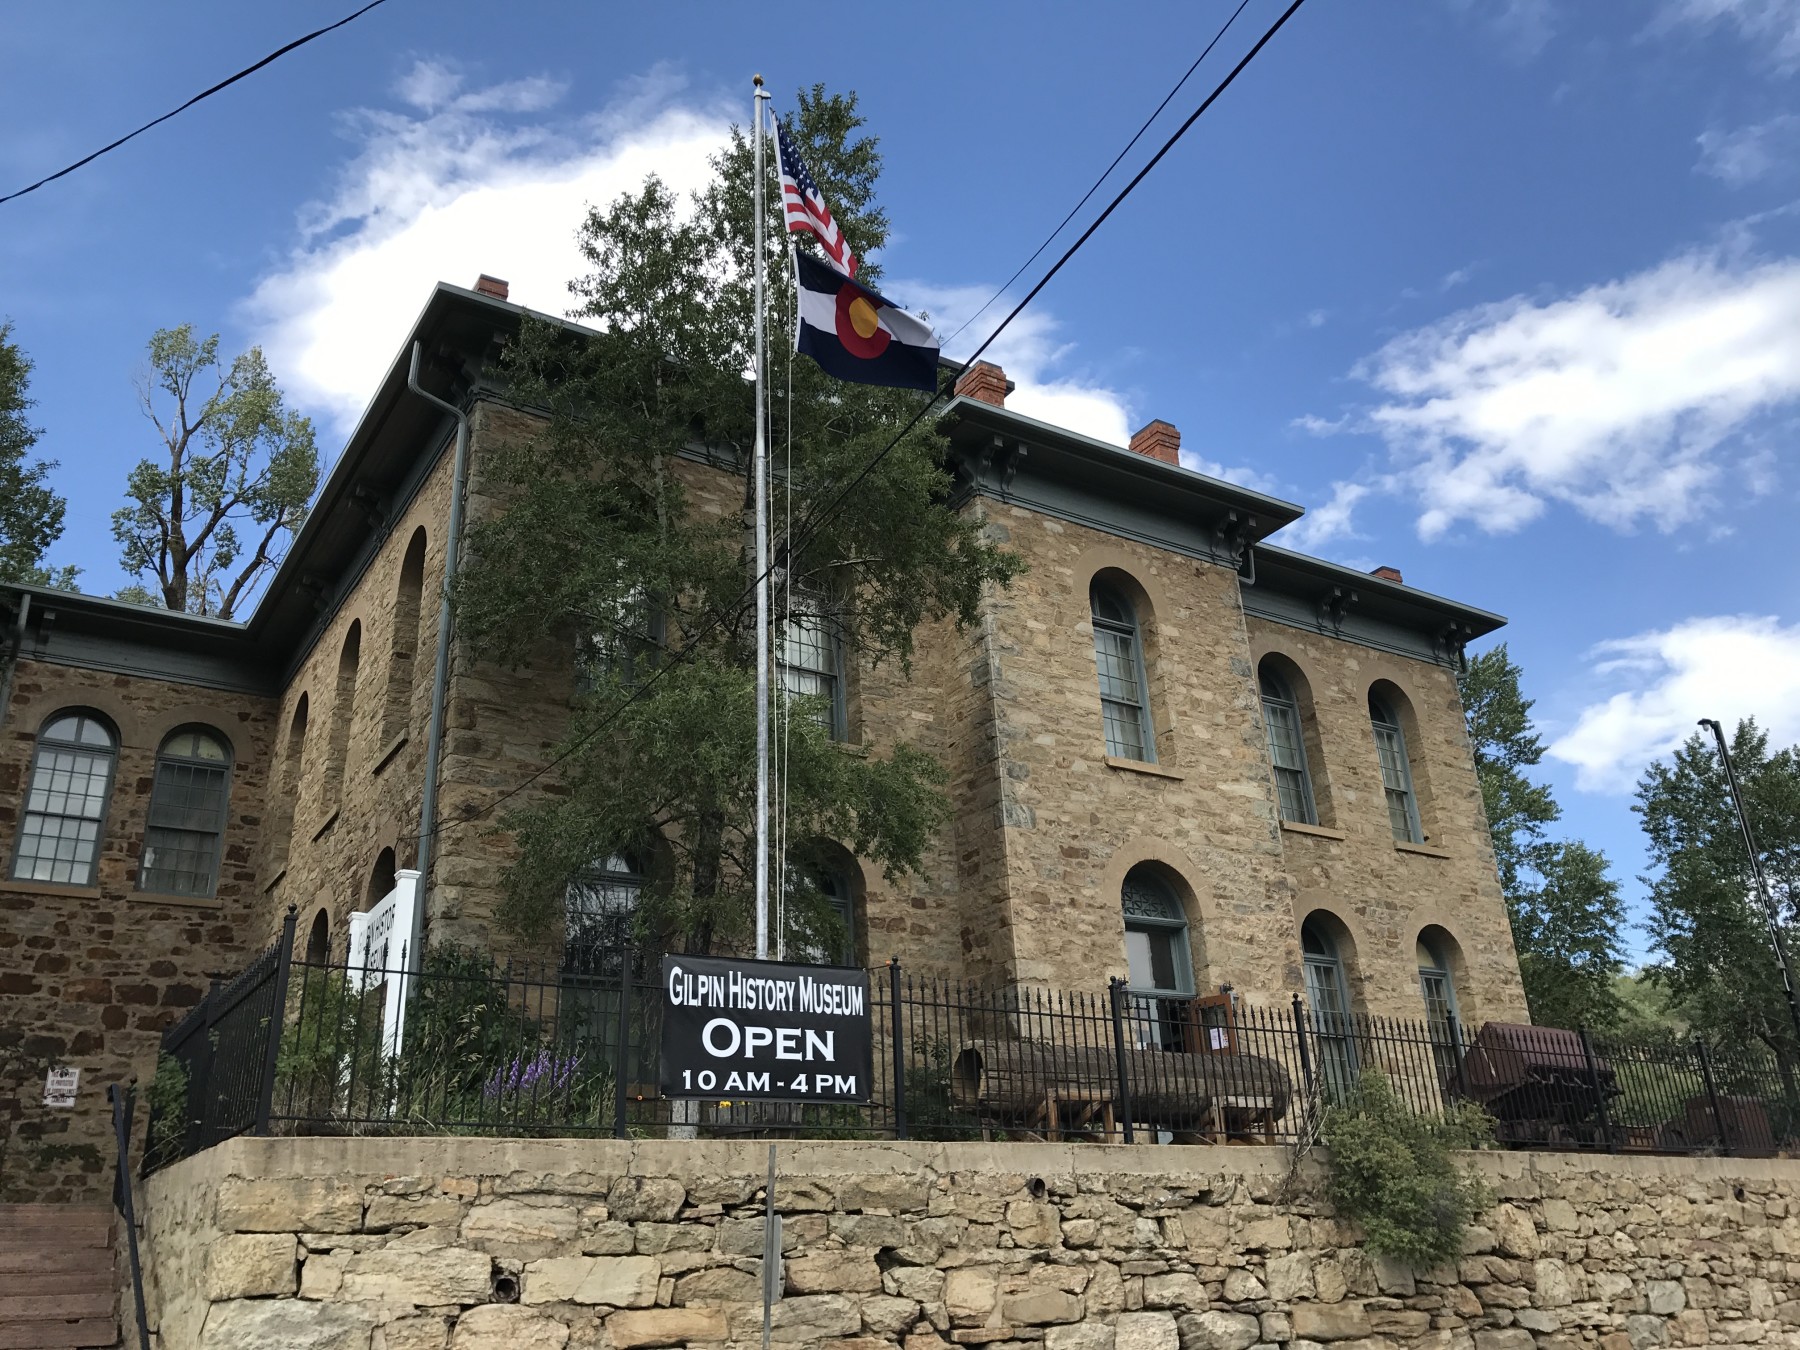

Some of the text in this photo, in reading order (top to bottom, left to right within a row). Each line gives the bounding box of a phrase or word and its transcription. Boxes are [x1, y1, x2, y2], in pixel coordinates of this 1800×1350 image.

[669, 966, 864, 1016] GILPIN HISTORY MUSEUM
[702, 1017, 835, 1062] OPEN
[683, 1069, 717, 1090] 10
[723, 1071, 770, 1092] AM
[790, 1073, 809, 1093] 4
[815, 1074, 857, 1095] PM
